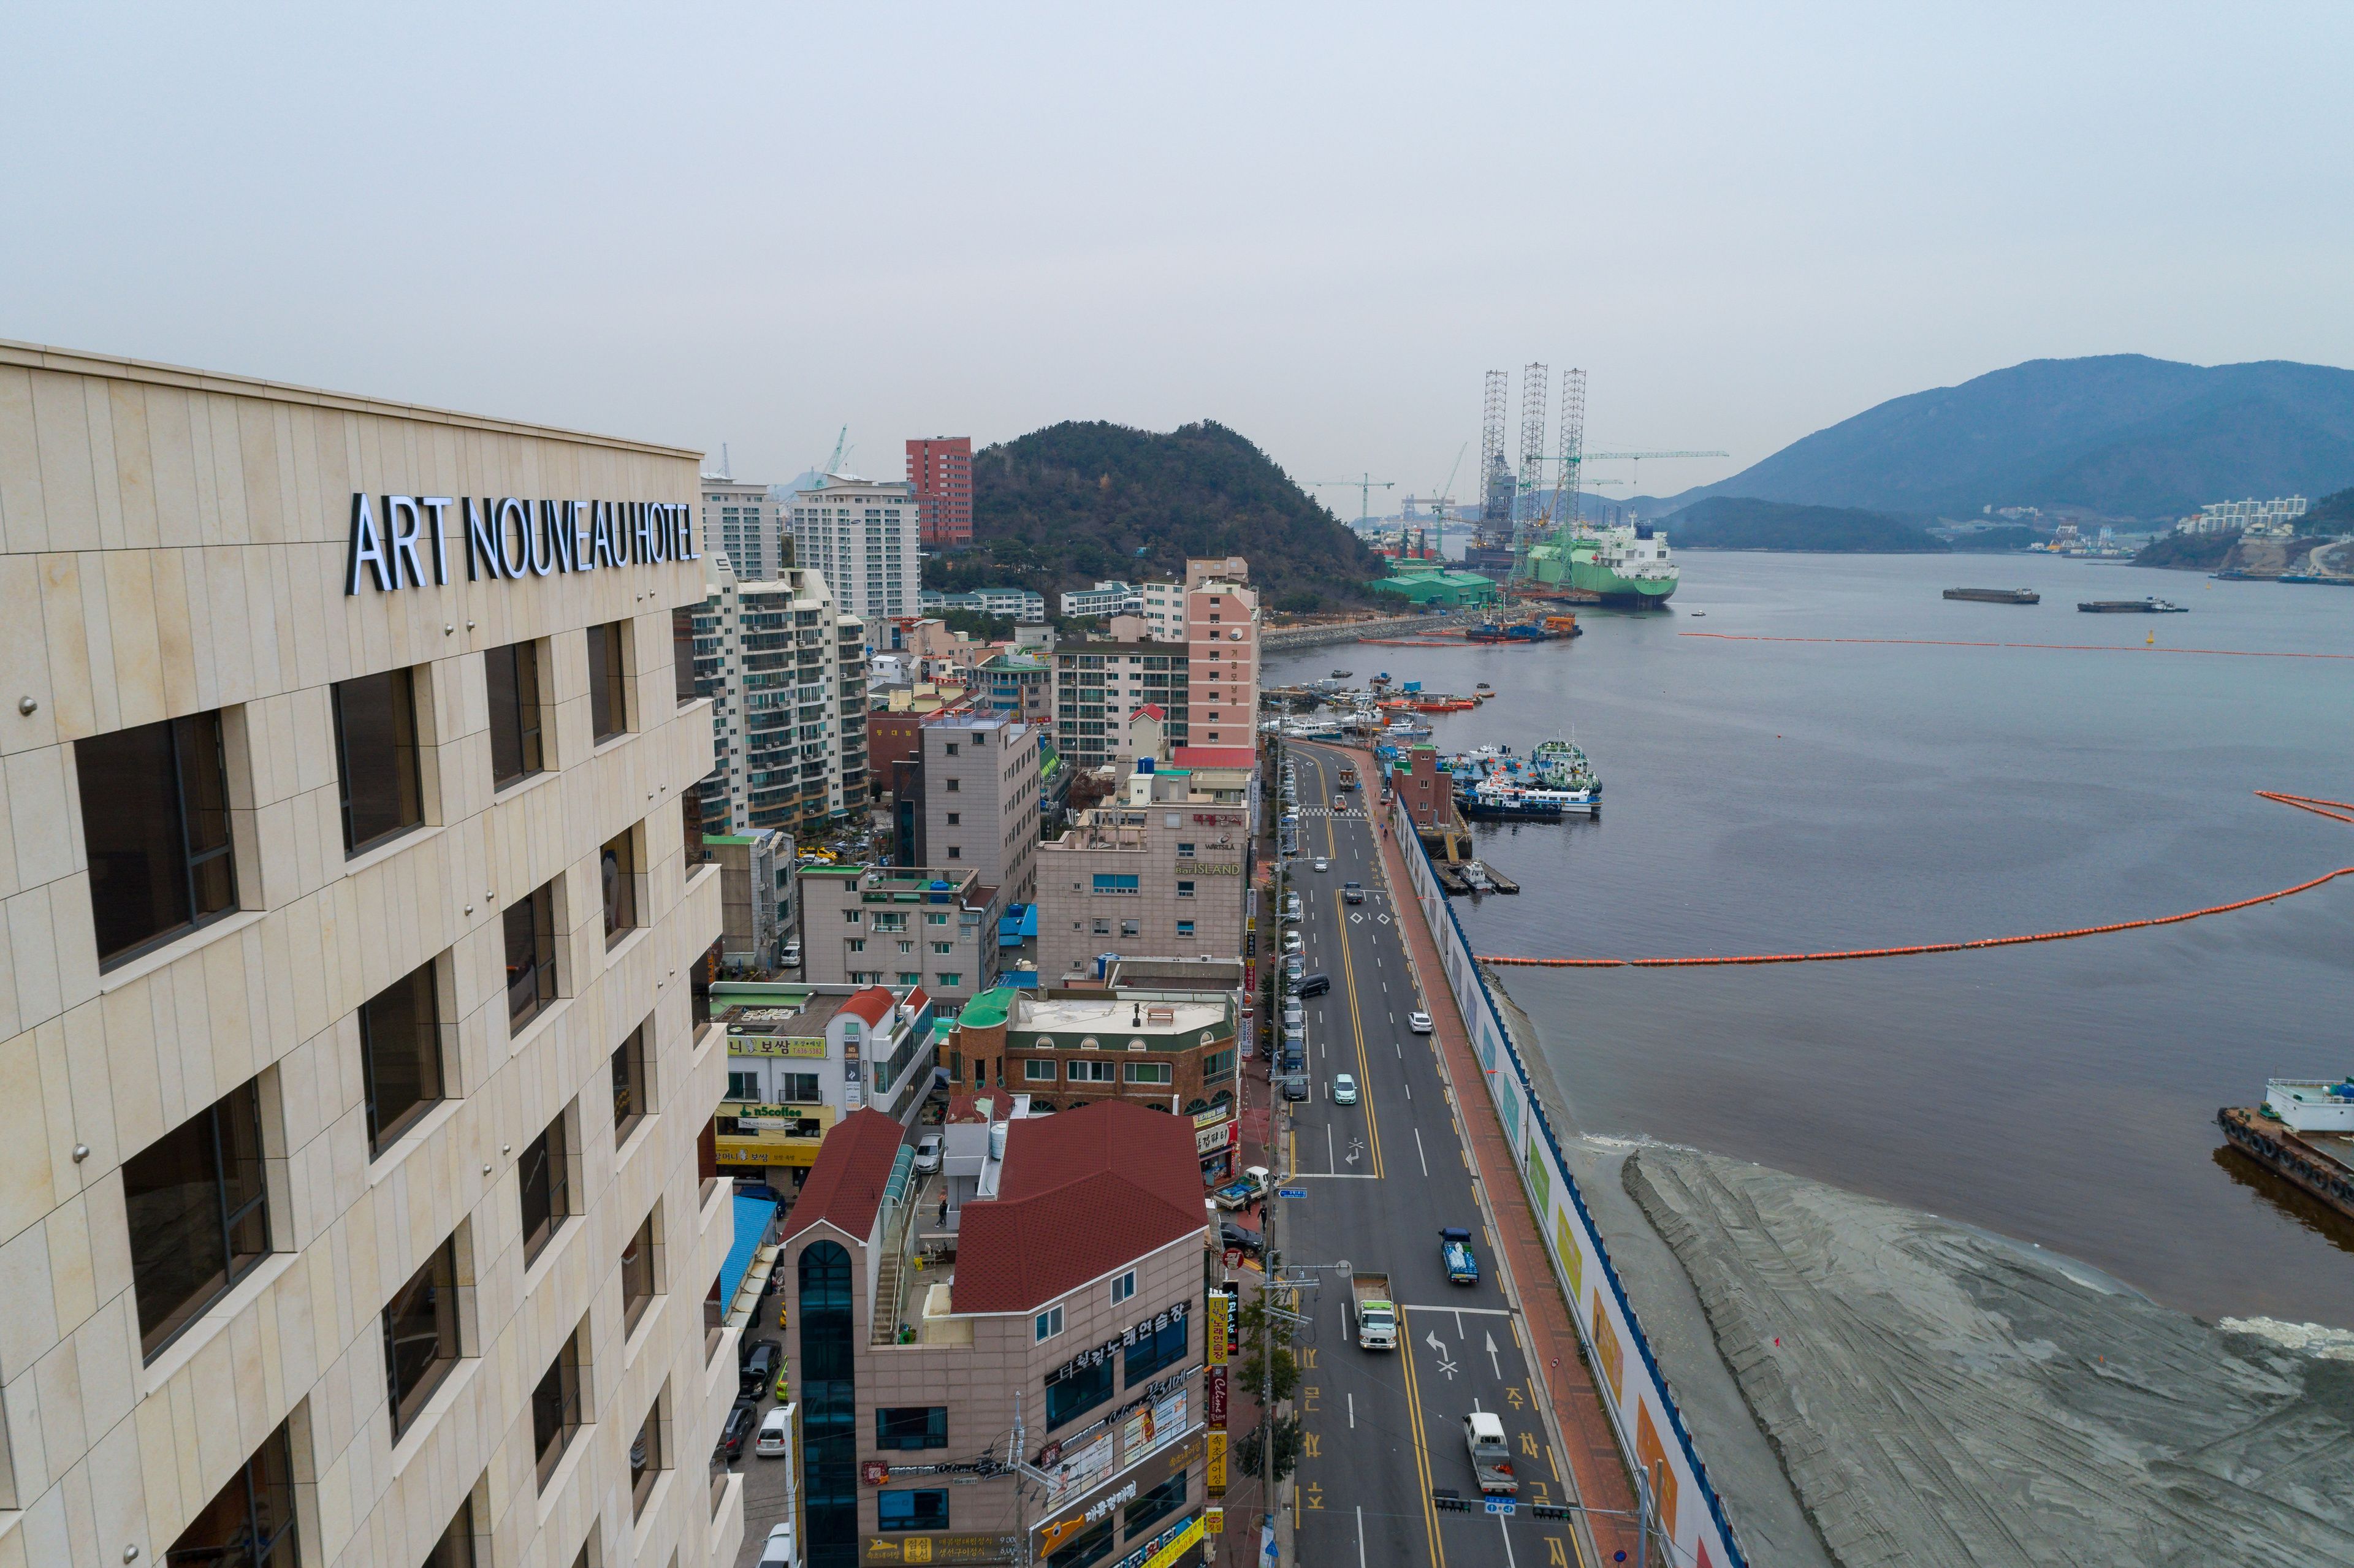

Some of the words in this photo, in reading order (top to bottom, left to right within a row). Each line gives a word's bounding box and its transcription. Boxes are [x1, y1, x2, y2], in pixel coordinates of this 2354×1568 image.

[345, 492, 453, 595] ART
[462, 497, 628, 580] NOUVEAU
[630, 501, 701, 565] HOTEL
[1194, 863, 1240, 875] ISLAND
[760, 1040, 791, 1054] 보쌈
[754, 1106, 802, 1117] n5coffee
[1107, 1303, 1184, 1358] 노래연습장
[1213, 1320, 1224, 1360] 노래연습장
[1102, 1468, 1110, 1478] 3F
[1212, 1435, 1223, 1485] 속초네어장
